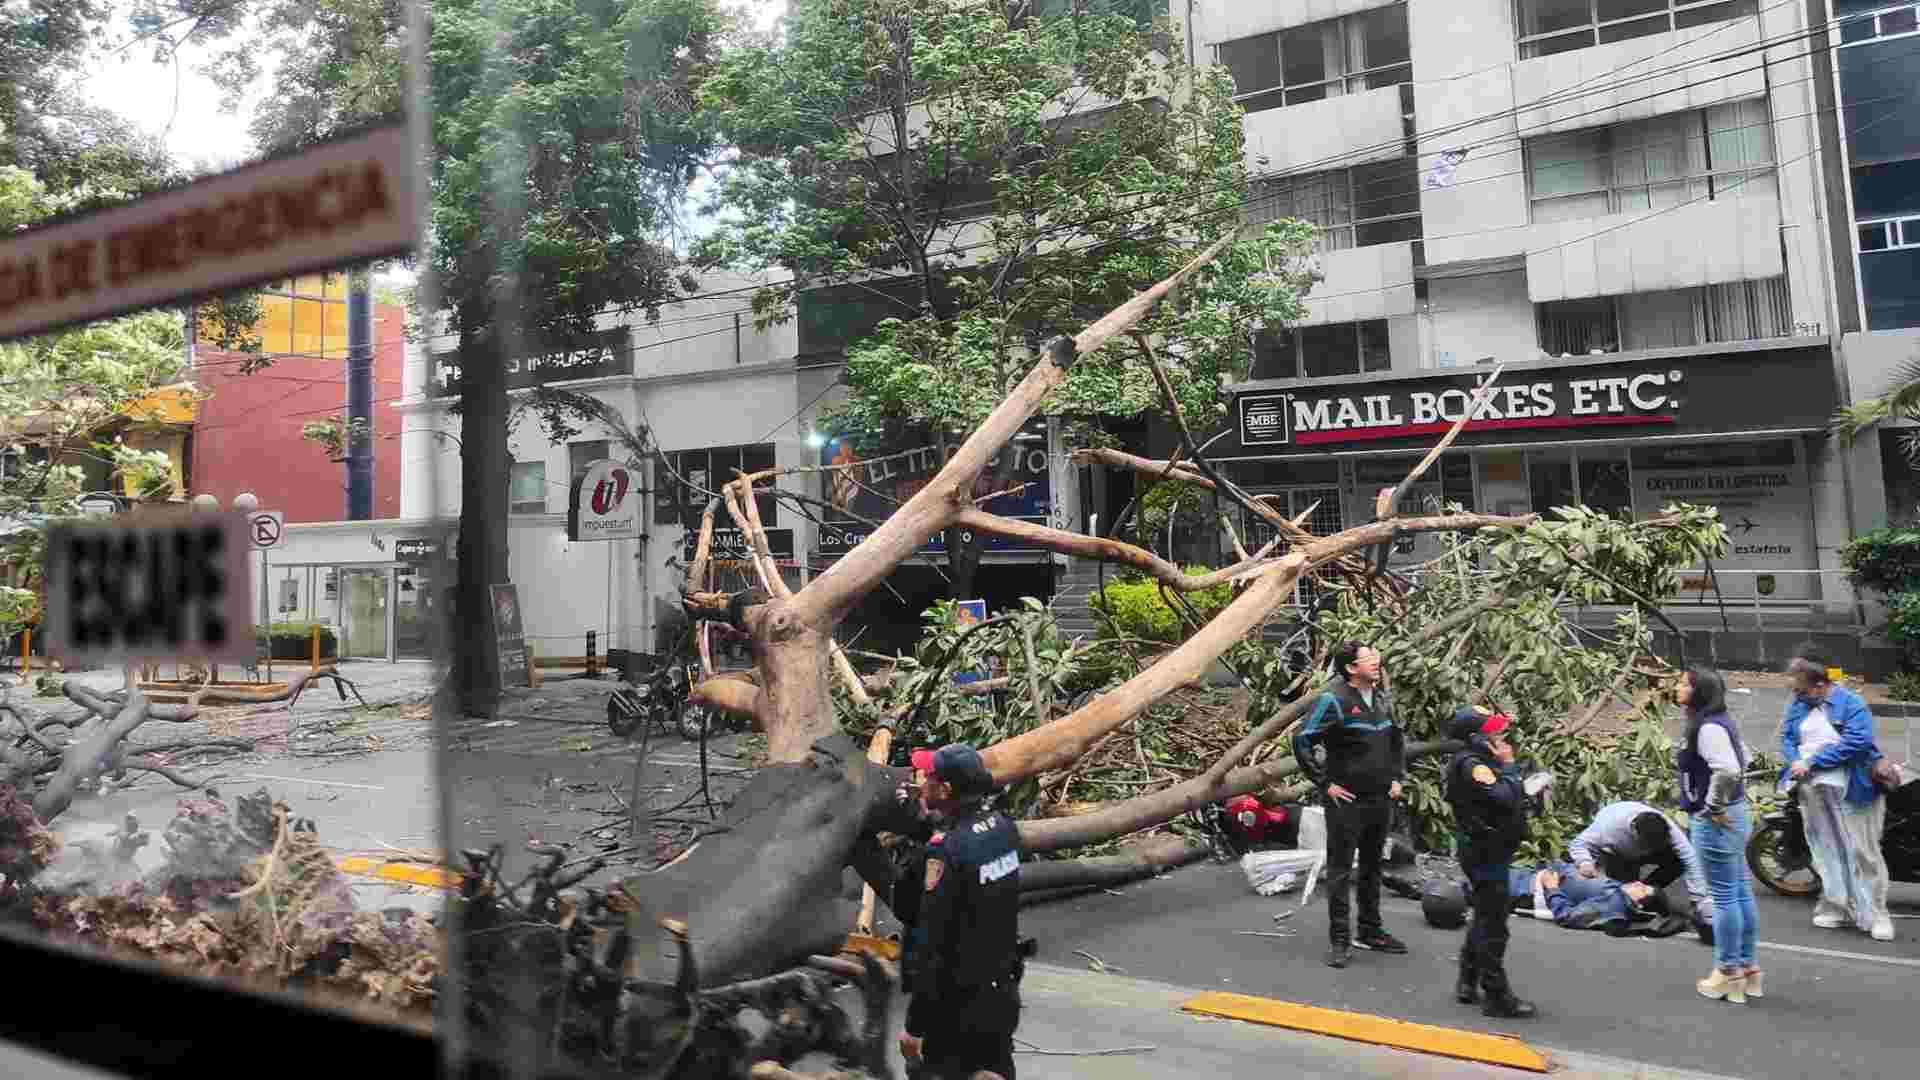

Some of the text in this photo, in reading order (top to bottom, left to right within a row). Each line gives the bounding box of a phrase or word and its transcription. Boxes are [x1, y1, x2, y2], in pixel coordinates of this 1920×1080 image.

[1249, 414, 1280, 427] MBE
[1293, 395, 1403, 431] MAIL
[1411, 382, 1556, 424] BOXES
